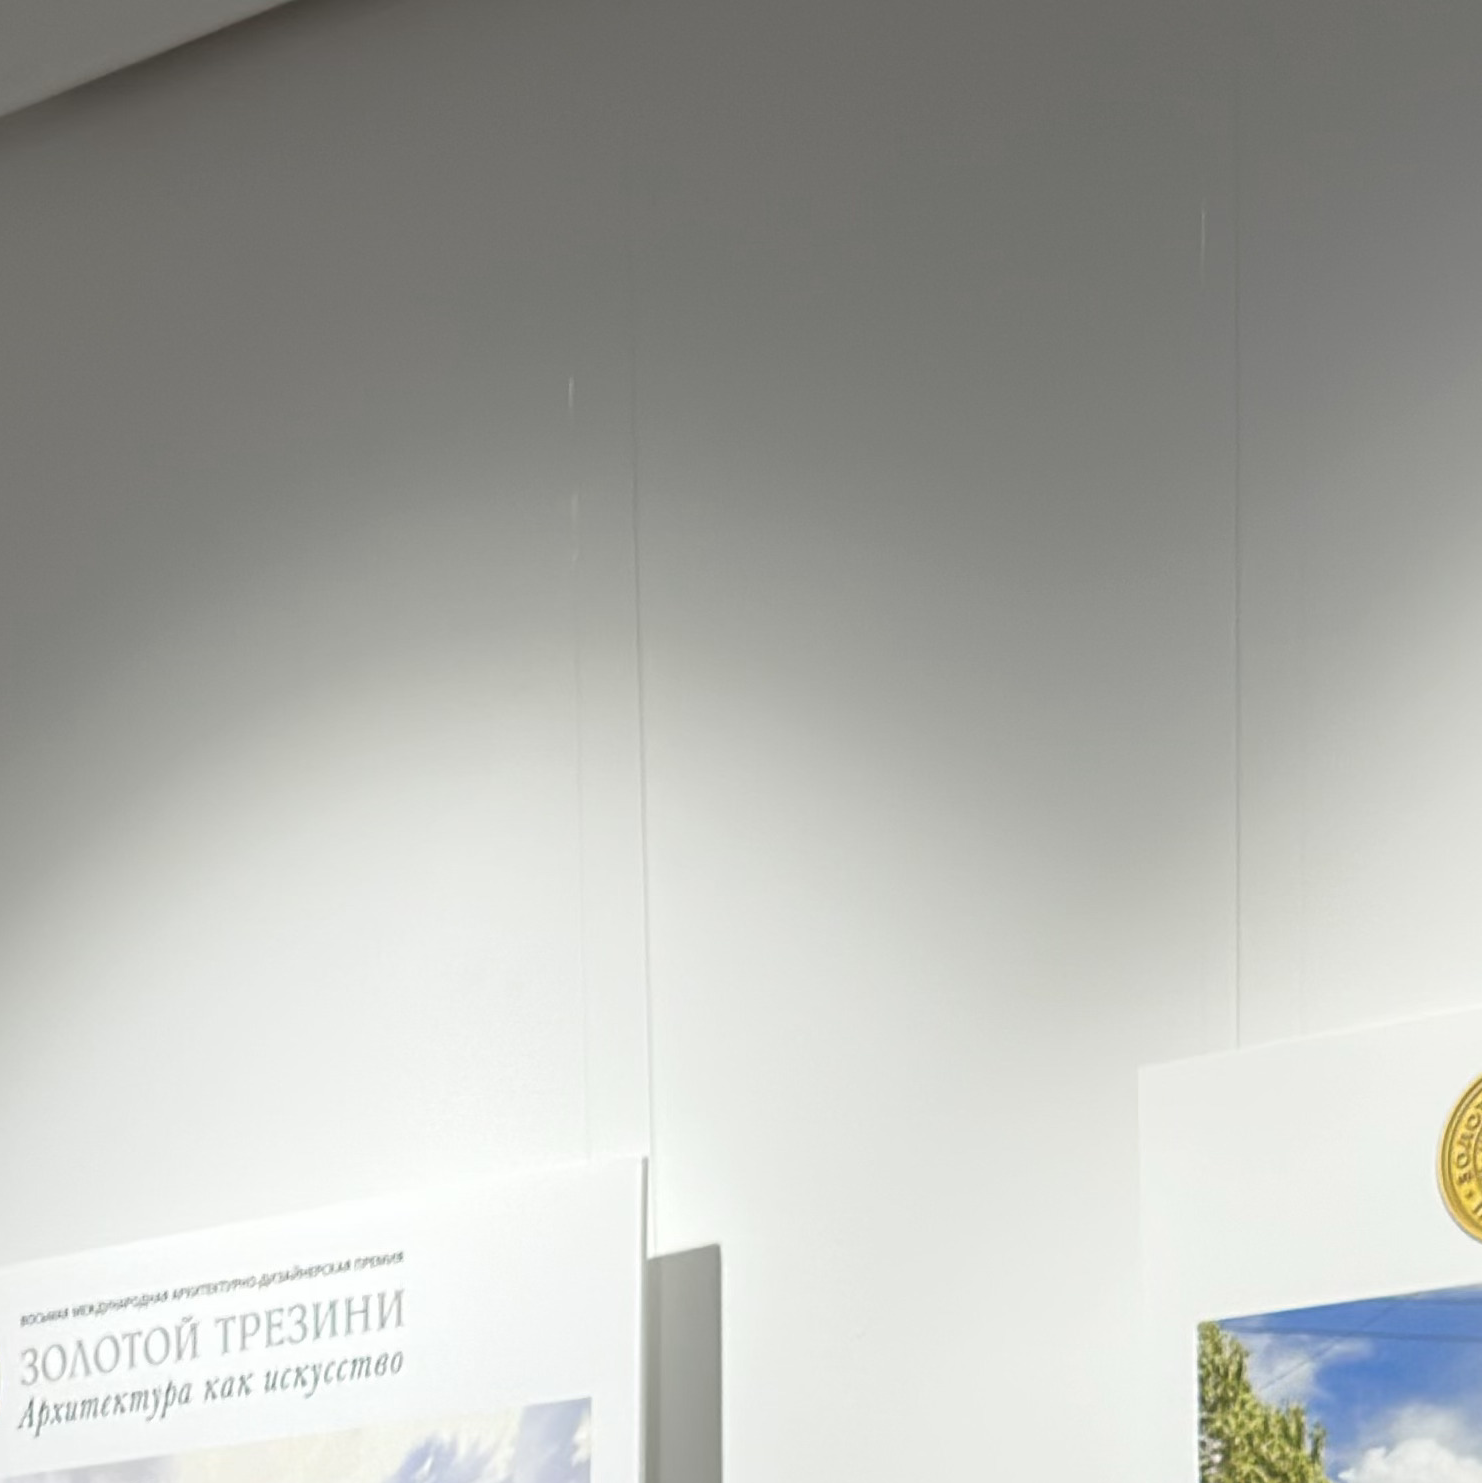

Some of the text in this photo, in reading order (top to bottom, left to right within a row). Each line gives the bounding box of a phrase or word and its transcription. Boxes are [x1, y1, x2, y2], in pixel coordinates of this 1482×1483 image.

[20, 1288, 405, 1386] ЗОЛОТОЙ ТРЕЗИНИ
[17, 1350, 403, 1438] Архитектура как искусство
